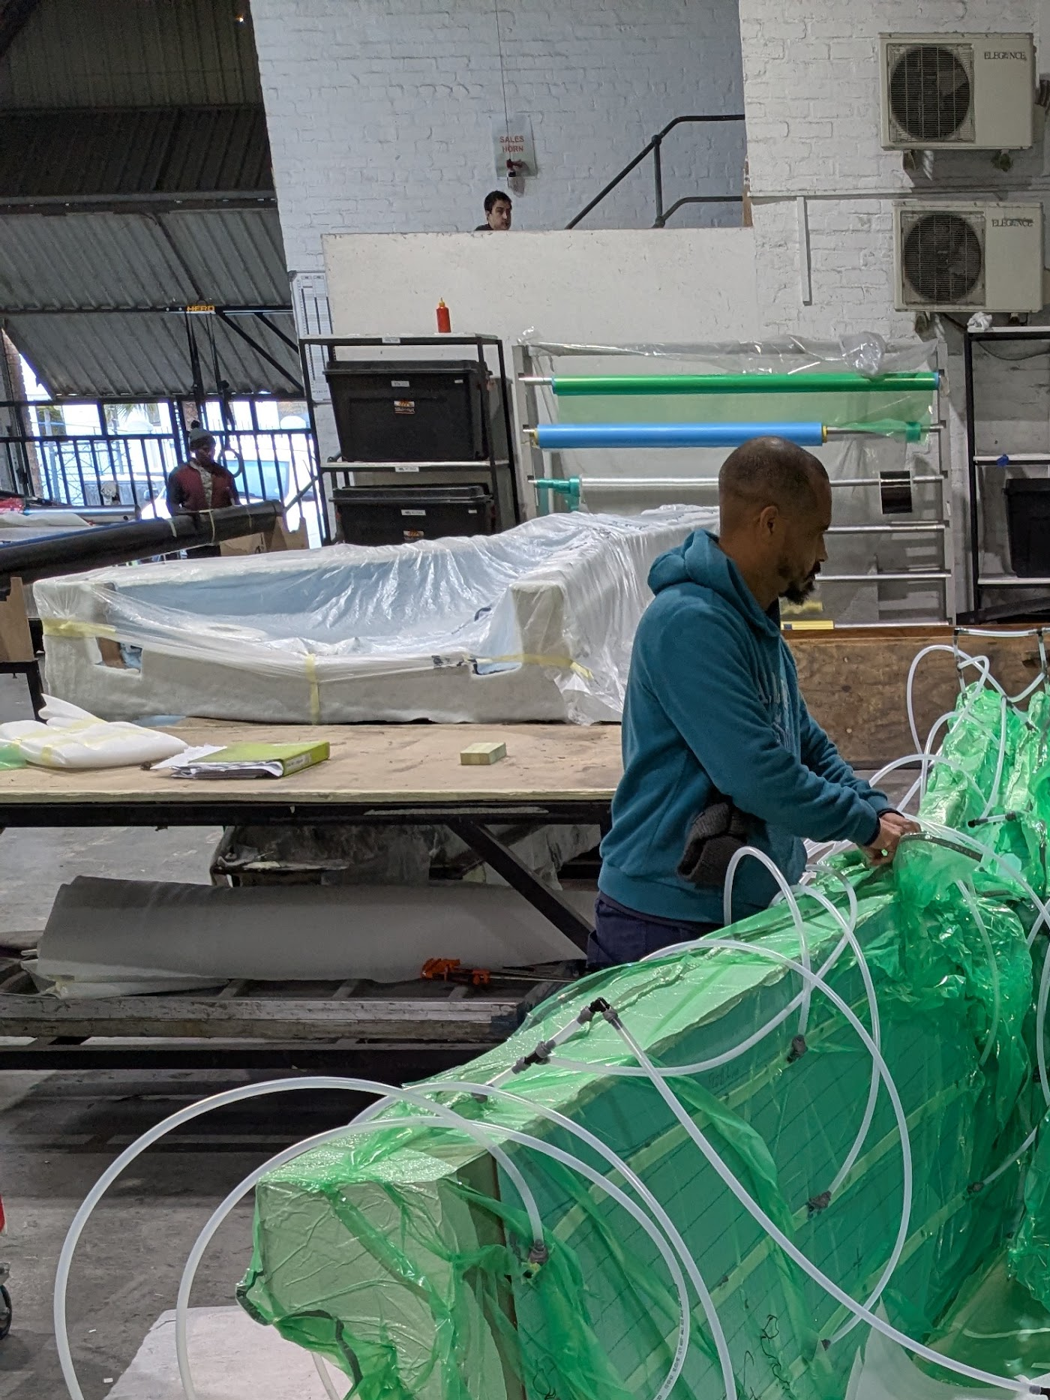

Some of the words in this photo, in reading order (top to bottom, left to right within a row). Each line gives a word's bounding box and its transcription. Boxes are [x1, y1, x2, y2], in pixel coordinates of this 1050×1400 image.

[984, 51, 1026, 60] ELEGANCE
[499, 135, 524, 143] SALES
[502, 145, 524, 153] HORN
